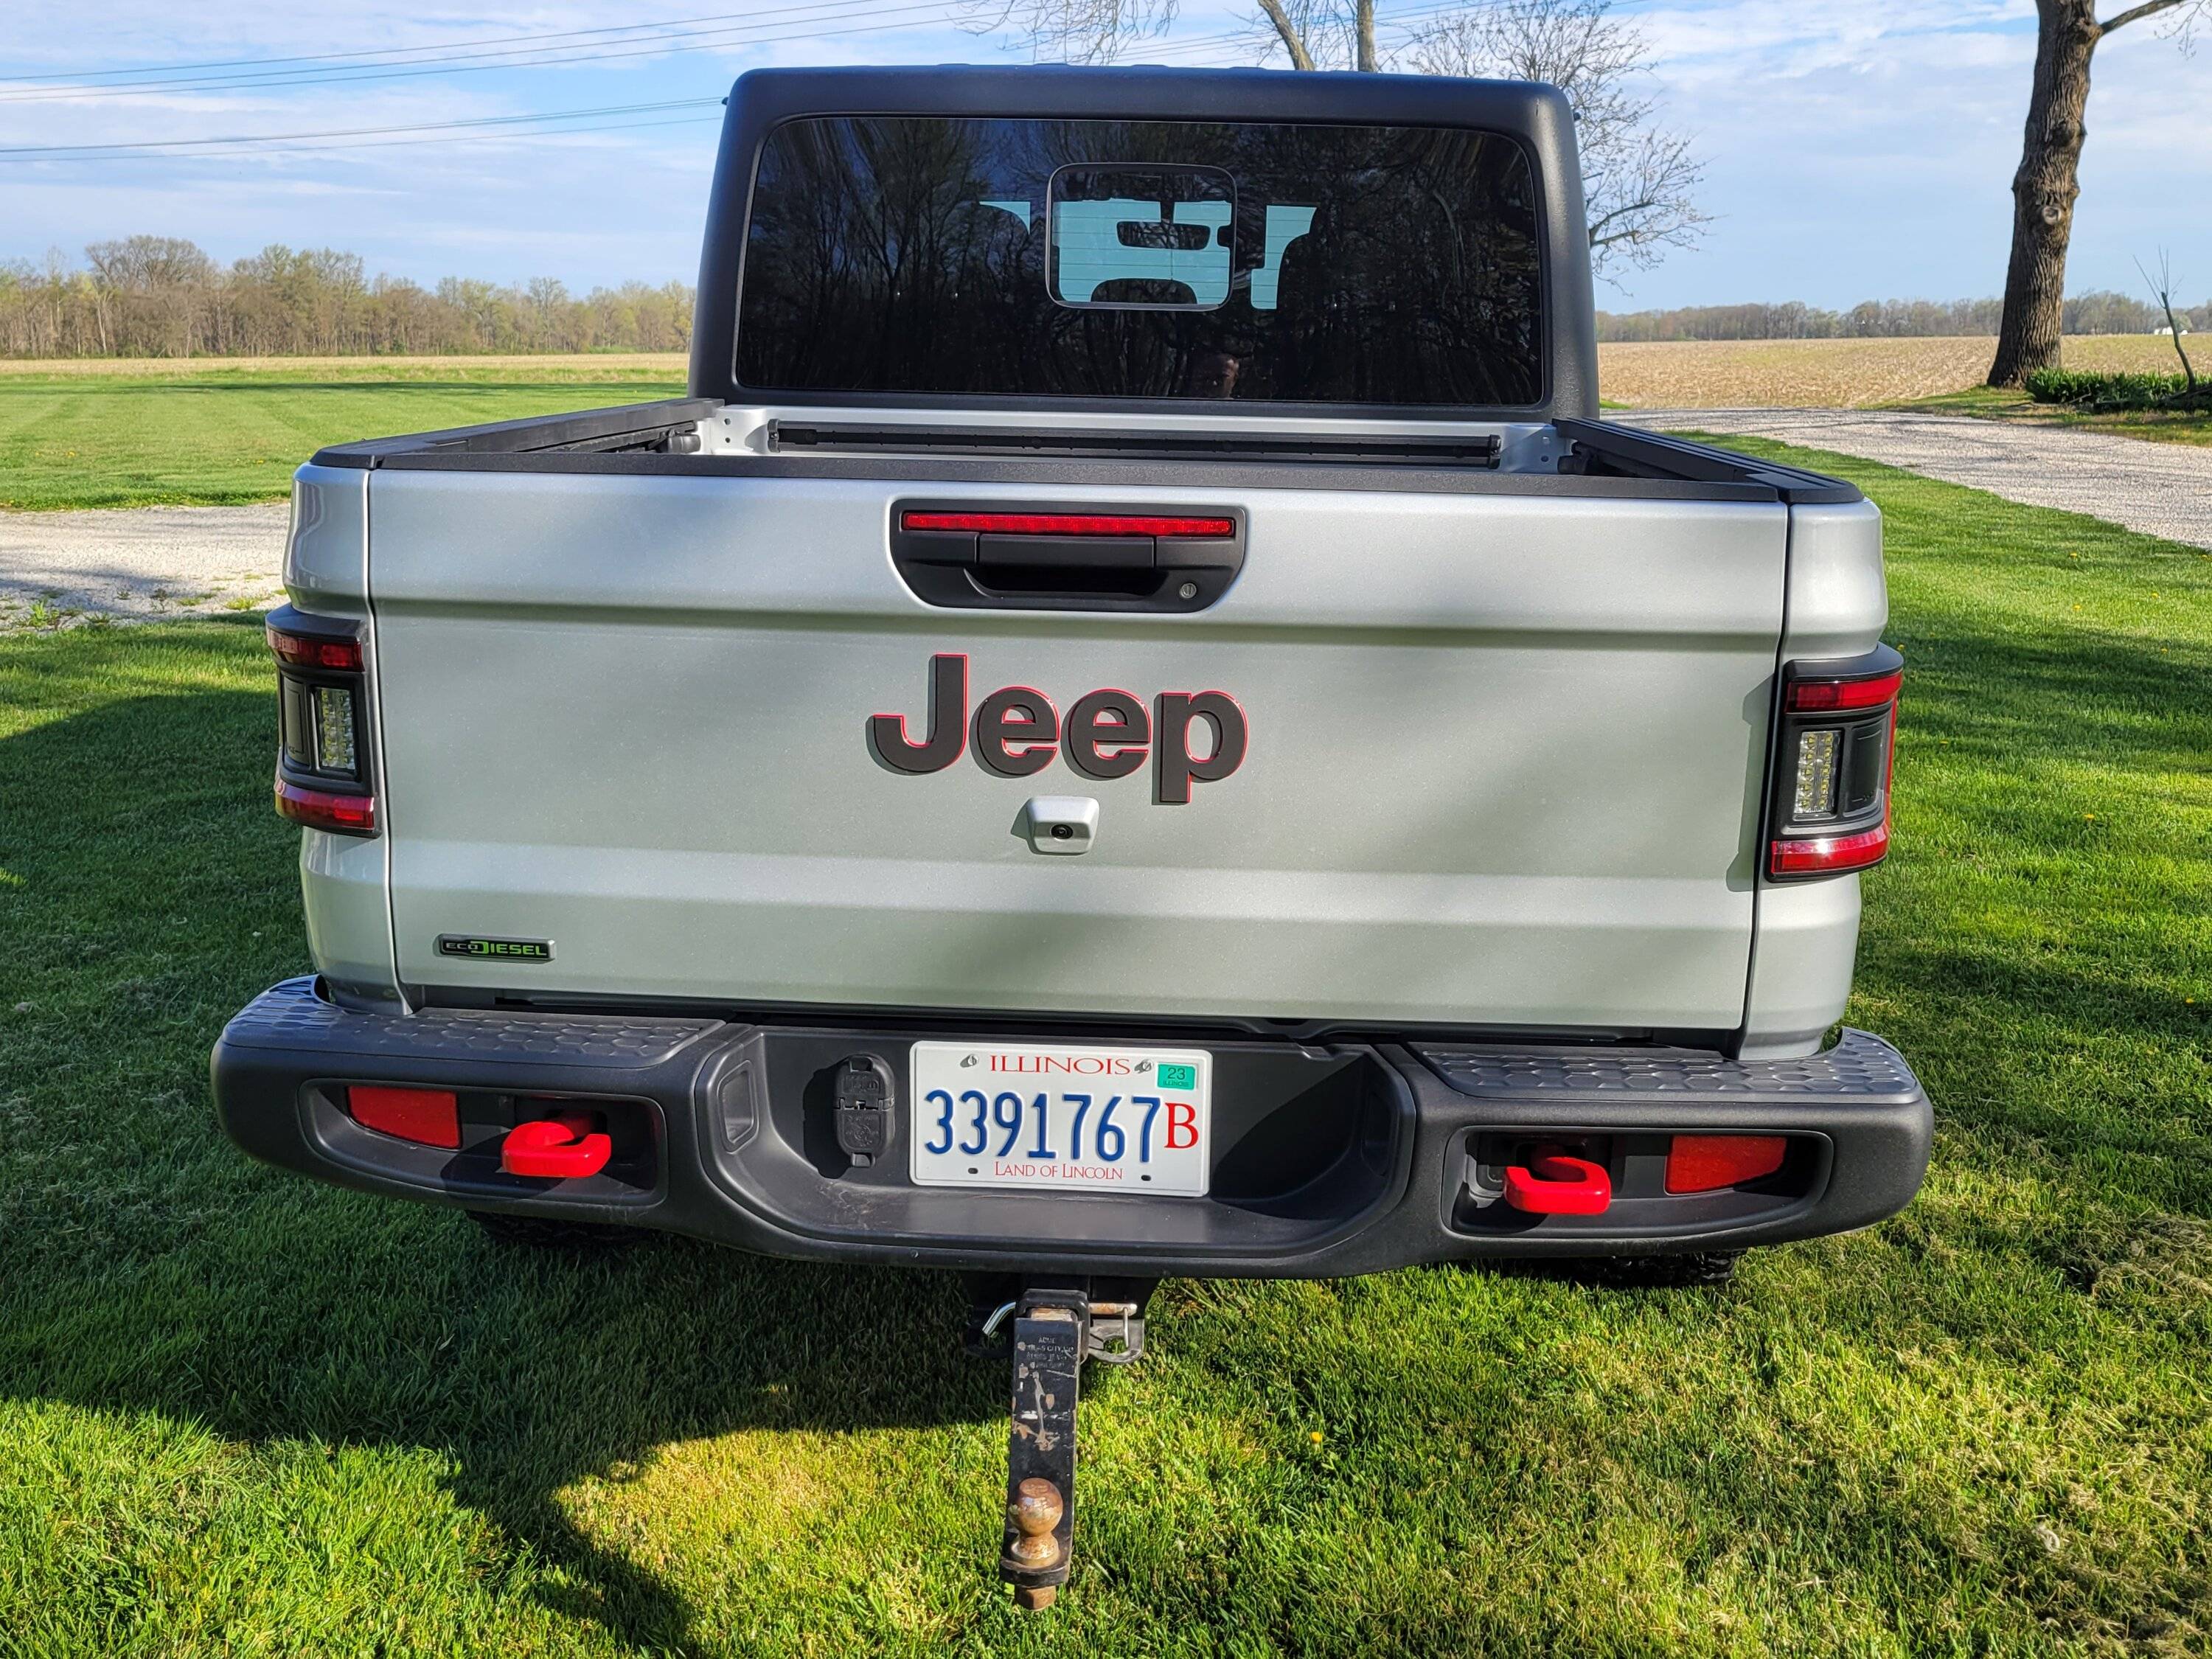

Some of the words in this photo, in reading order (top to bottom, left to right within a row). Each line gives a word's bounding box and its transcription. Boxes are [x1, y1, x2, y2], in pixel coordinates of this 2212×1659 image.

[872, 653, 1248, 804] Jeep
[990, 1054, 1130, 1075] ILLINOIS
[1167, 1067, 1186, 1080] 23
